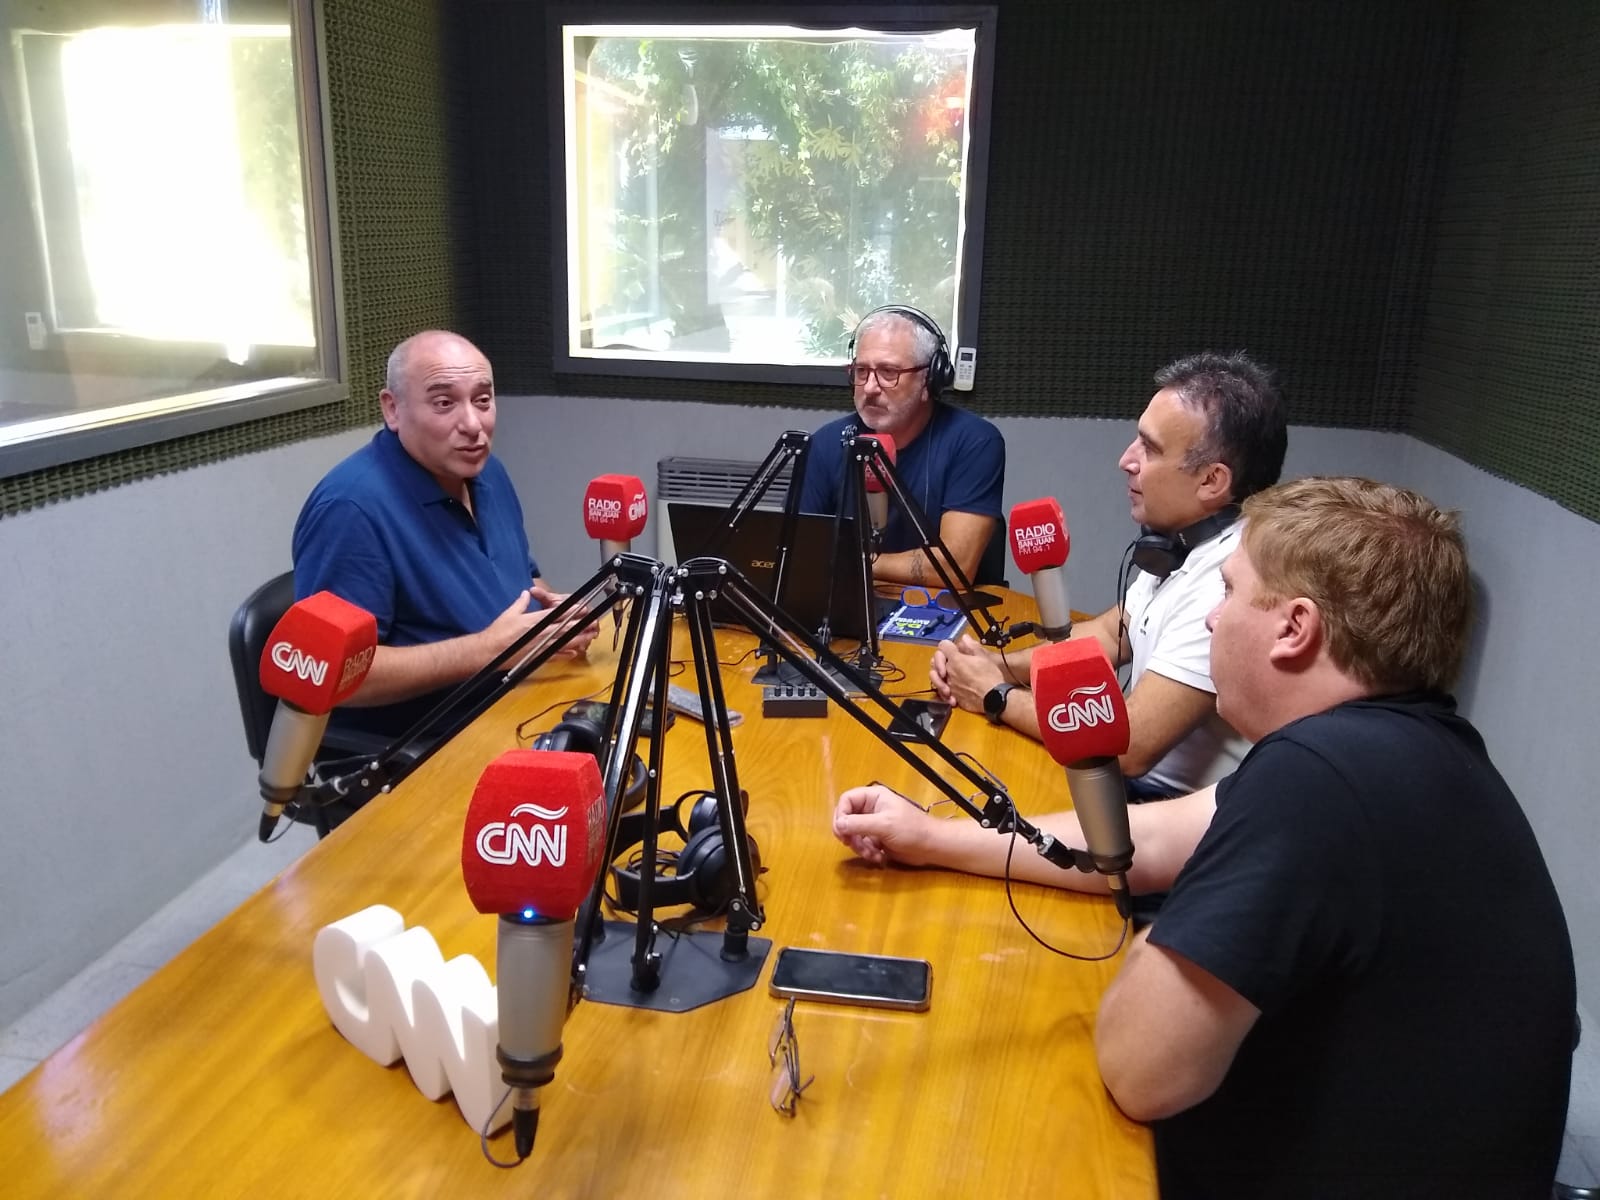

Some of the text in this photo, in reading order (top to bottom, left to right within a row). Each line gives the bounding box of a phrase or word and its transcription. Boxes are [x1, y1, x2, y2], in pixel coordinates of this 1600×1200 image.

[588, 498, 621, 510] RADIO
[1015, 523, 1056, 541] RADIO
[1018, 536, 1055, 549] SAN JUAN
[1018, 546, 1032, 556] FM
[751, 559, 776, 569] acer
[271, 641, 329, 687] CNN
[1047, 692, 1115, 732] CNN
[476, 820, 568, 868] CNN
